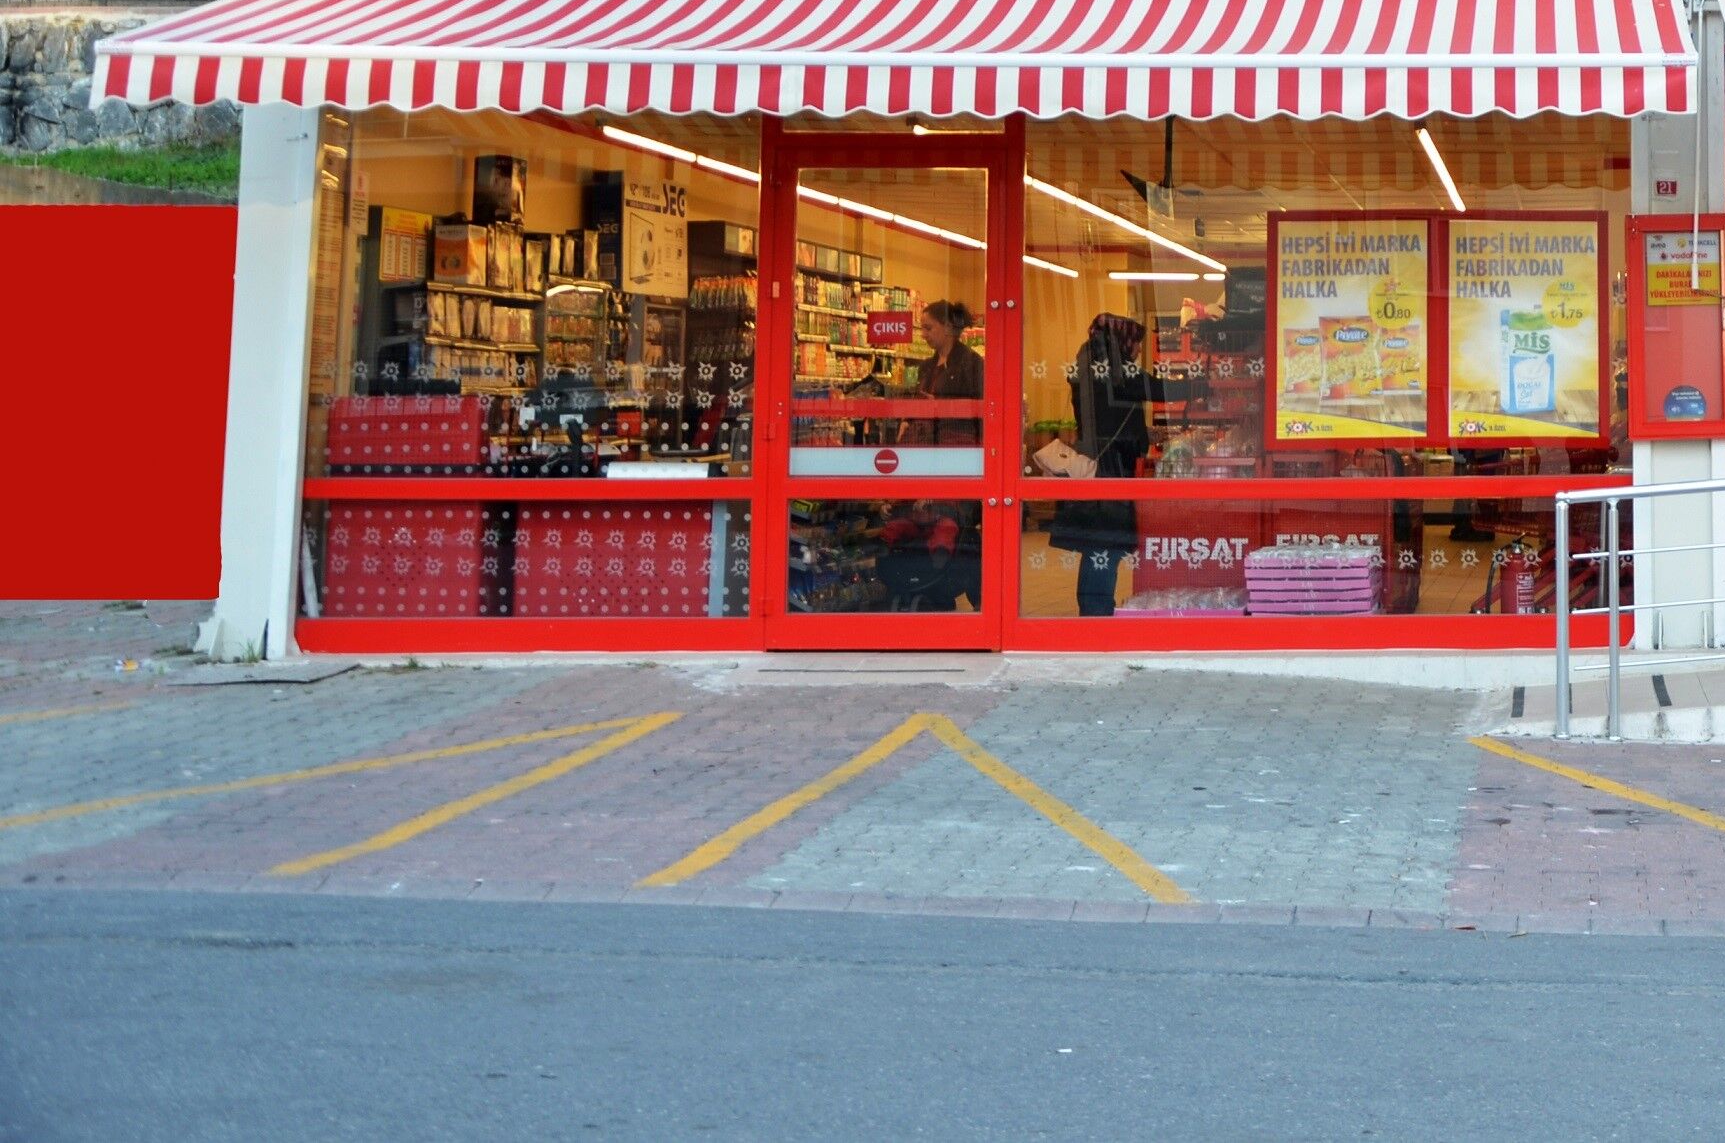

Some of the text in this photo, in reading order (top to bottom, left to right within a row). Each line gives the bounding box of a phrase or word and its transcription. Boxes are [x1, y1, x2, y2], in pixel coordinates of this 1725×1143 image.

[1282, 231, 1421, 254] HEPSİ İYİ MARKA
[1456, 232, 1595, 254] HEPSİ İYİ MARKA
[1282, 256, 1390, 277] FABRİKADAN
[1456, 256, 1564, 277] FABRİKADAN
[1282, 280, 1338, 299] HALKA
[1456, 280, 1512, 299] HALKA
[873, 321, 907, 336] ÇIKIŞ
[1145, 537, 1249, 561] FIRSAT
